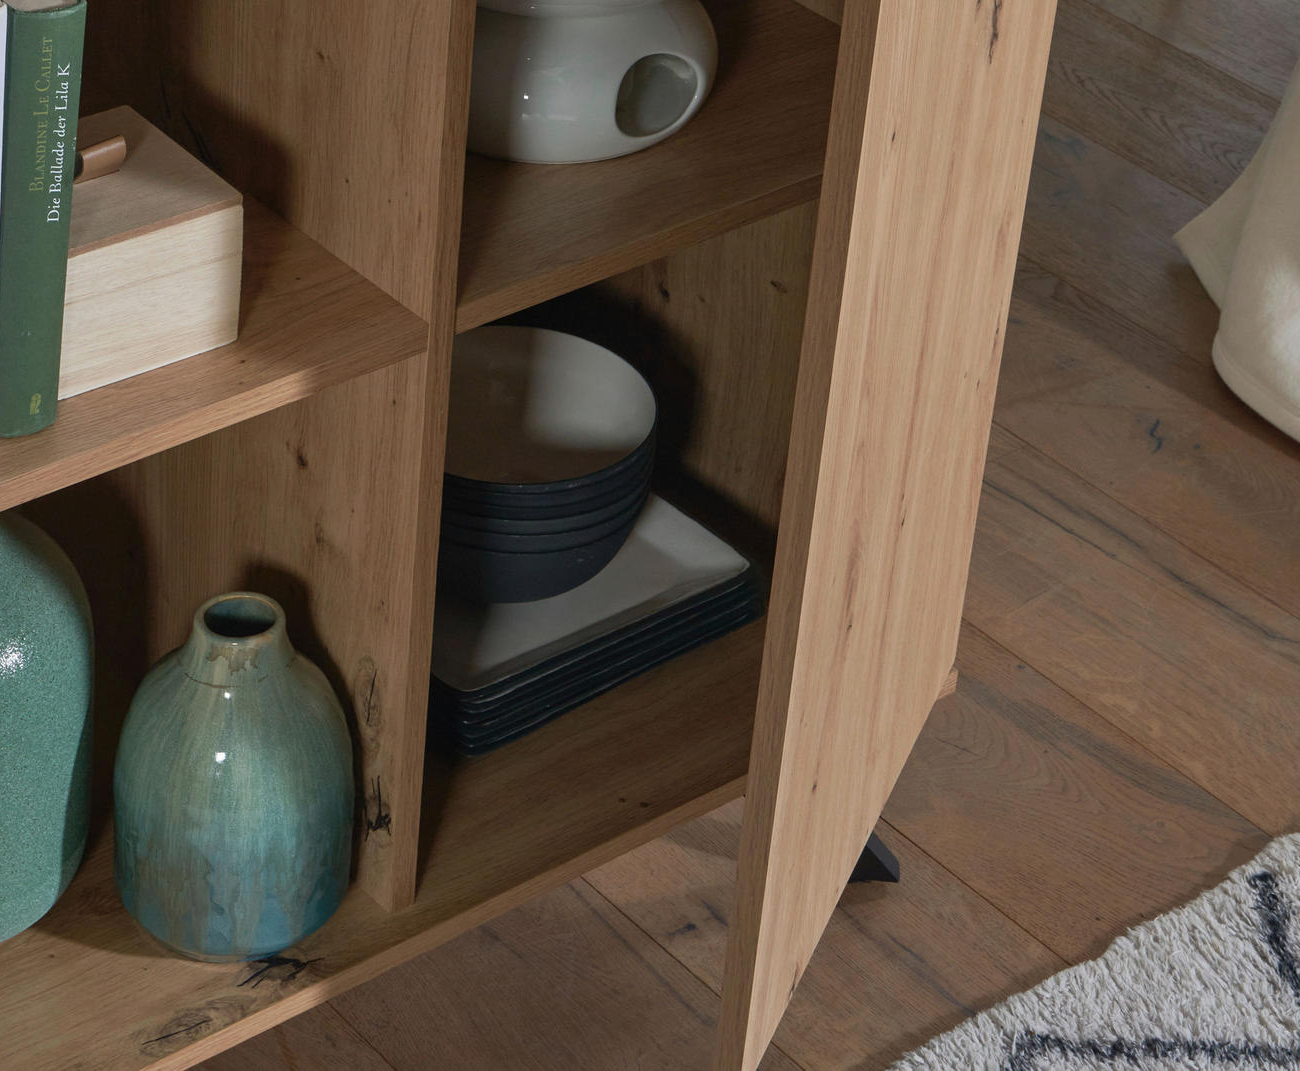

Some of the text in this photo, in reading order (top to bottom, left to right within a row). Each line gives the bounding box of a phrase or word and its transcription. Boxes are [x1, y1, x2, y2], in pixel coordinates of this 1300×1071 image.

[47, 62, 70, 223] Die Ballade der Lila K
